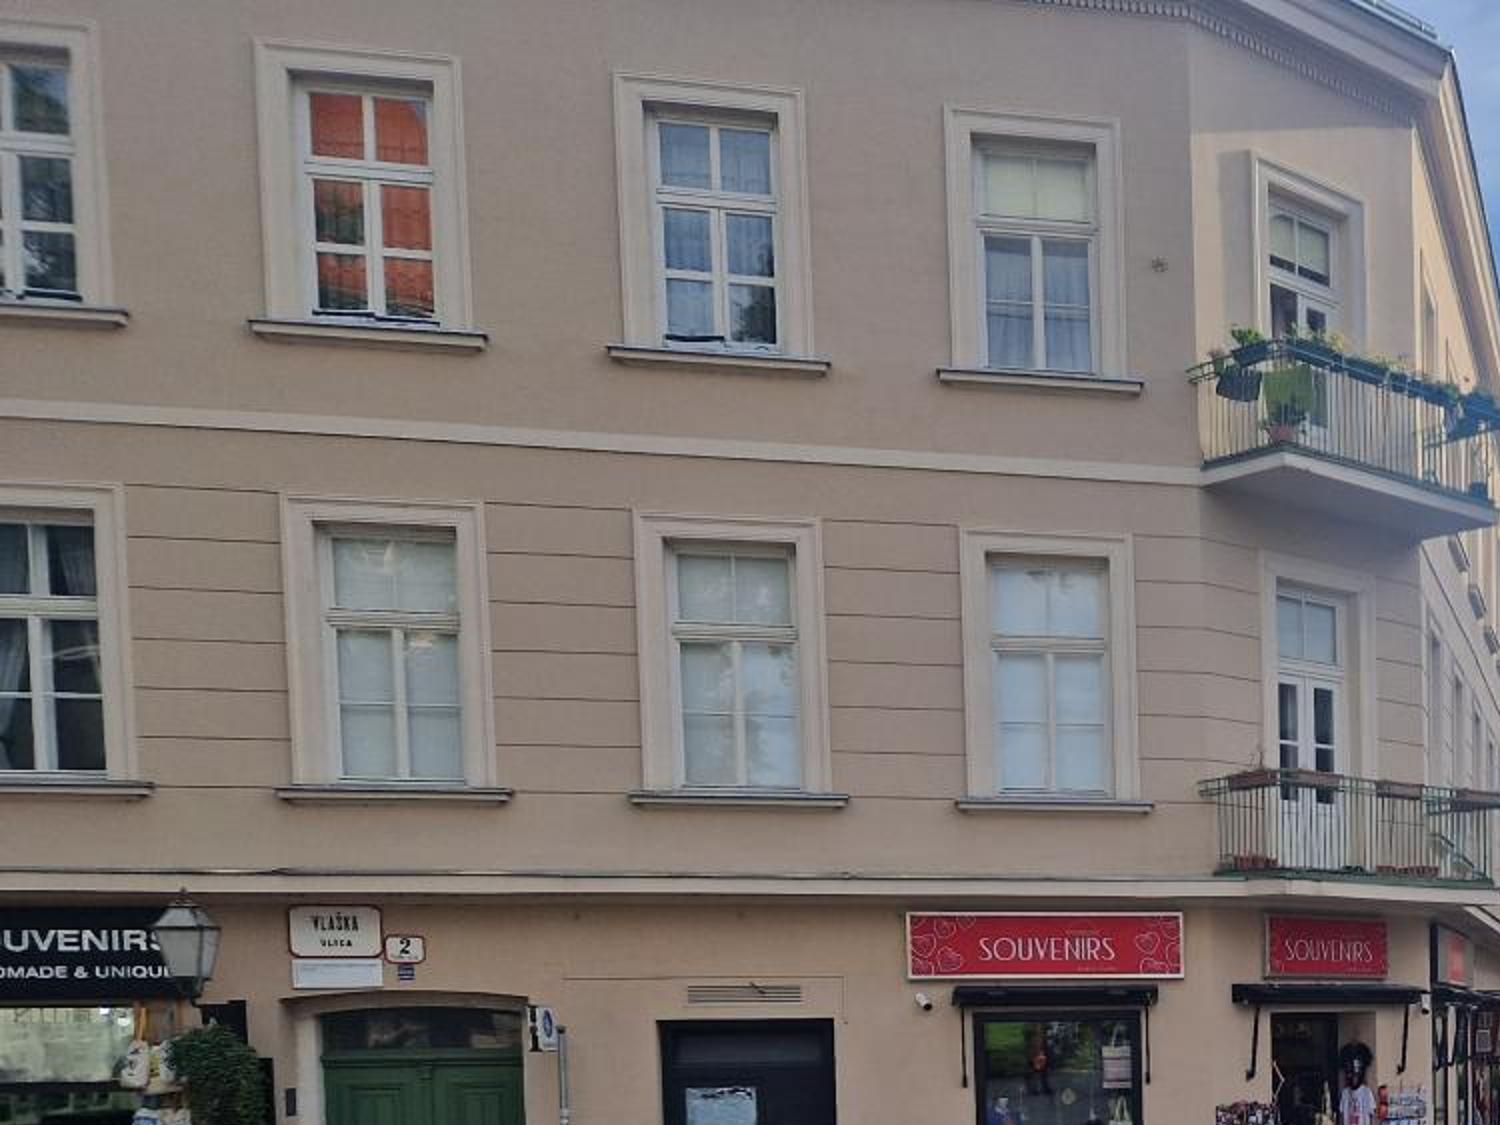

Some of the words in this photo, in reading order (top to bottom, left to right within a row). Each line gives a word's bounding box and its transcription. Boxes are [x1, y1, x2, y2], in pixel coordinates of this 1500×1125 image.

[311, 911, 359, 931] VLAŠKA
[0, 929, 161, 952] UVENIRS
[399, 938, 411, 955] 2
[979, 937, 1116, 961] SOUVENIRS
[1284, 939, 1374, 963] SOUVENIRS
[74, 965, 89, 979] &
